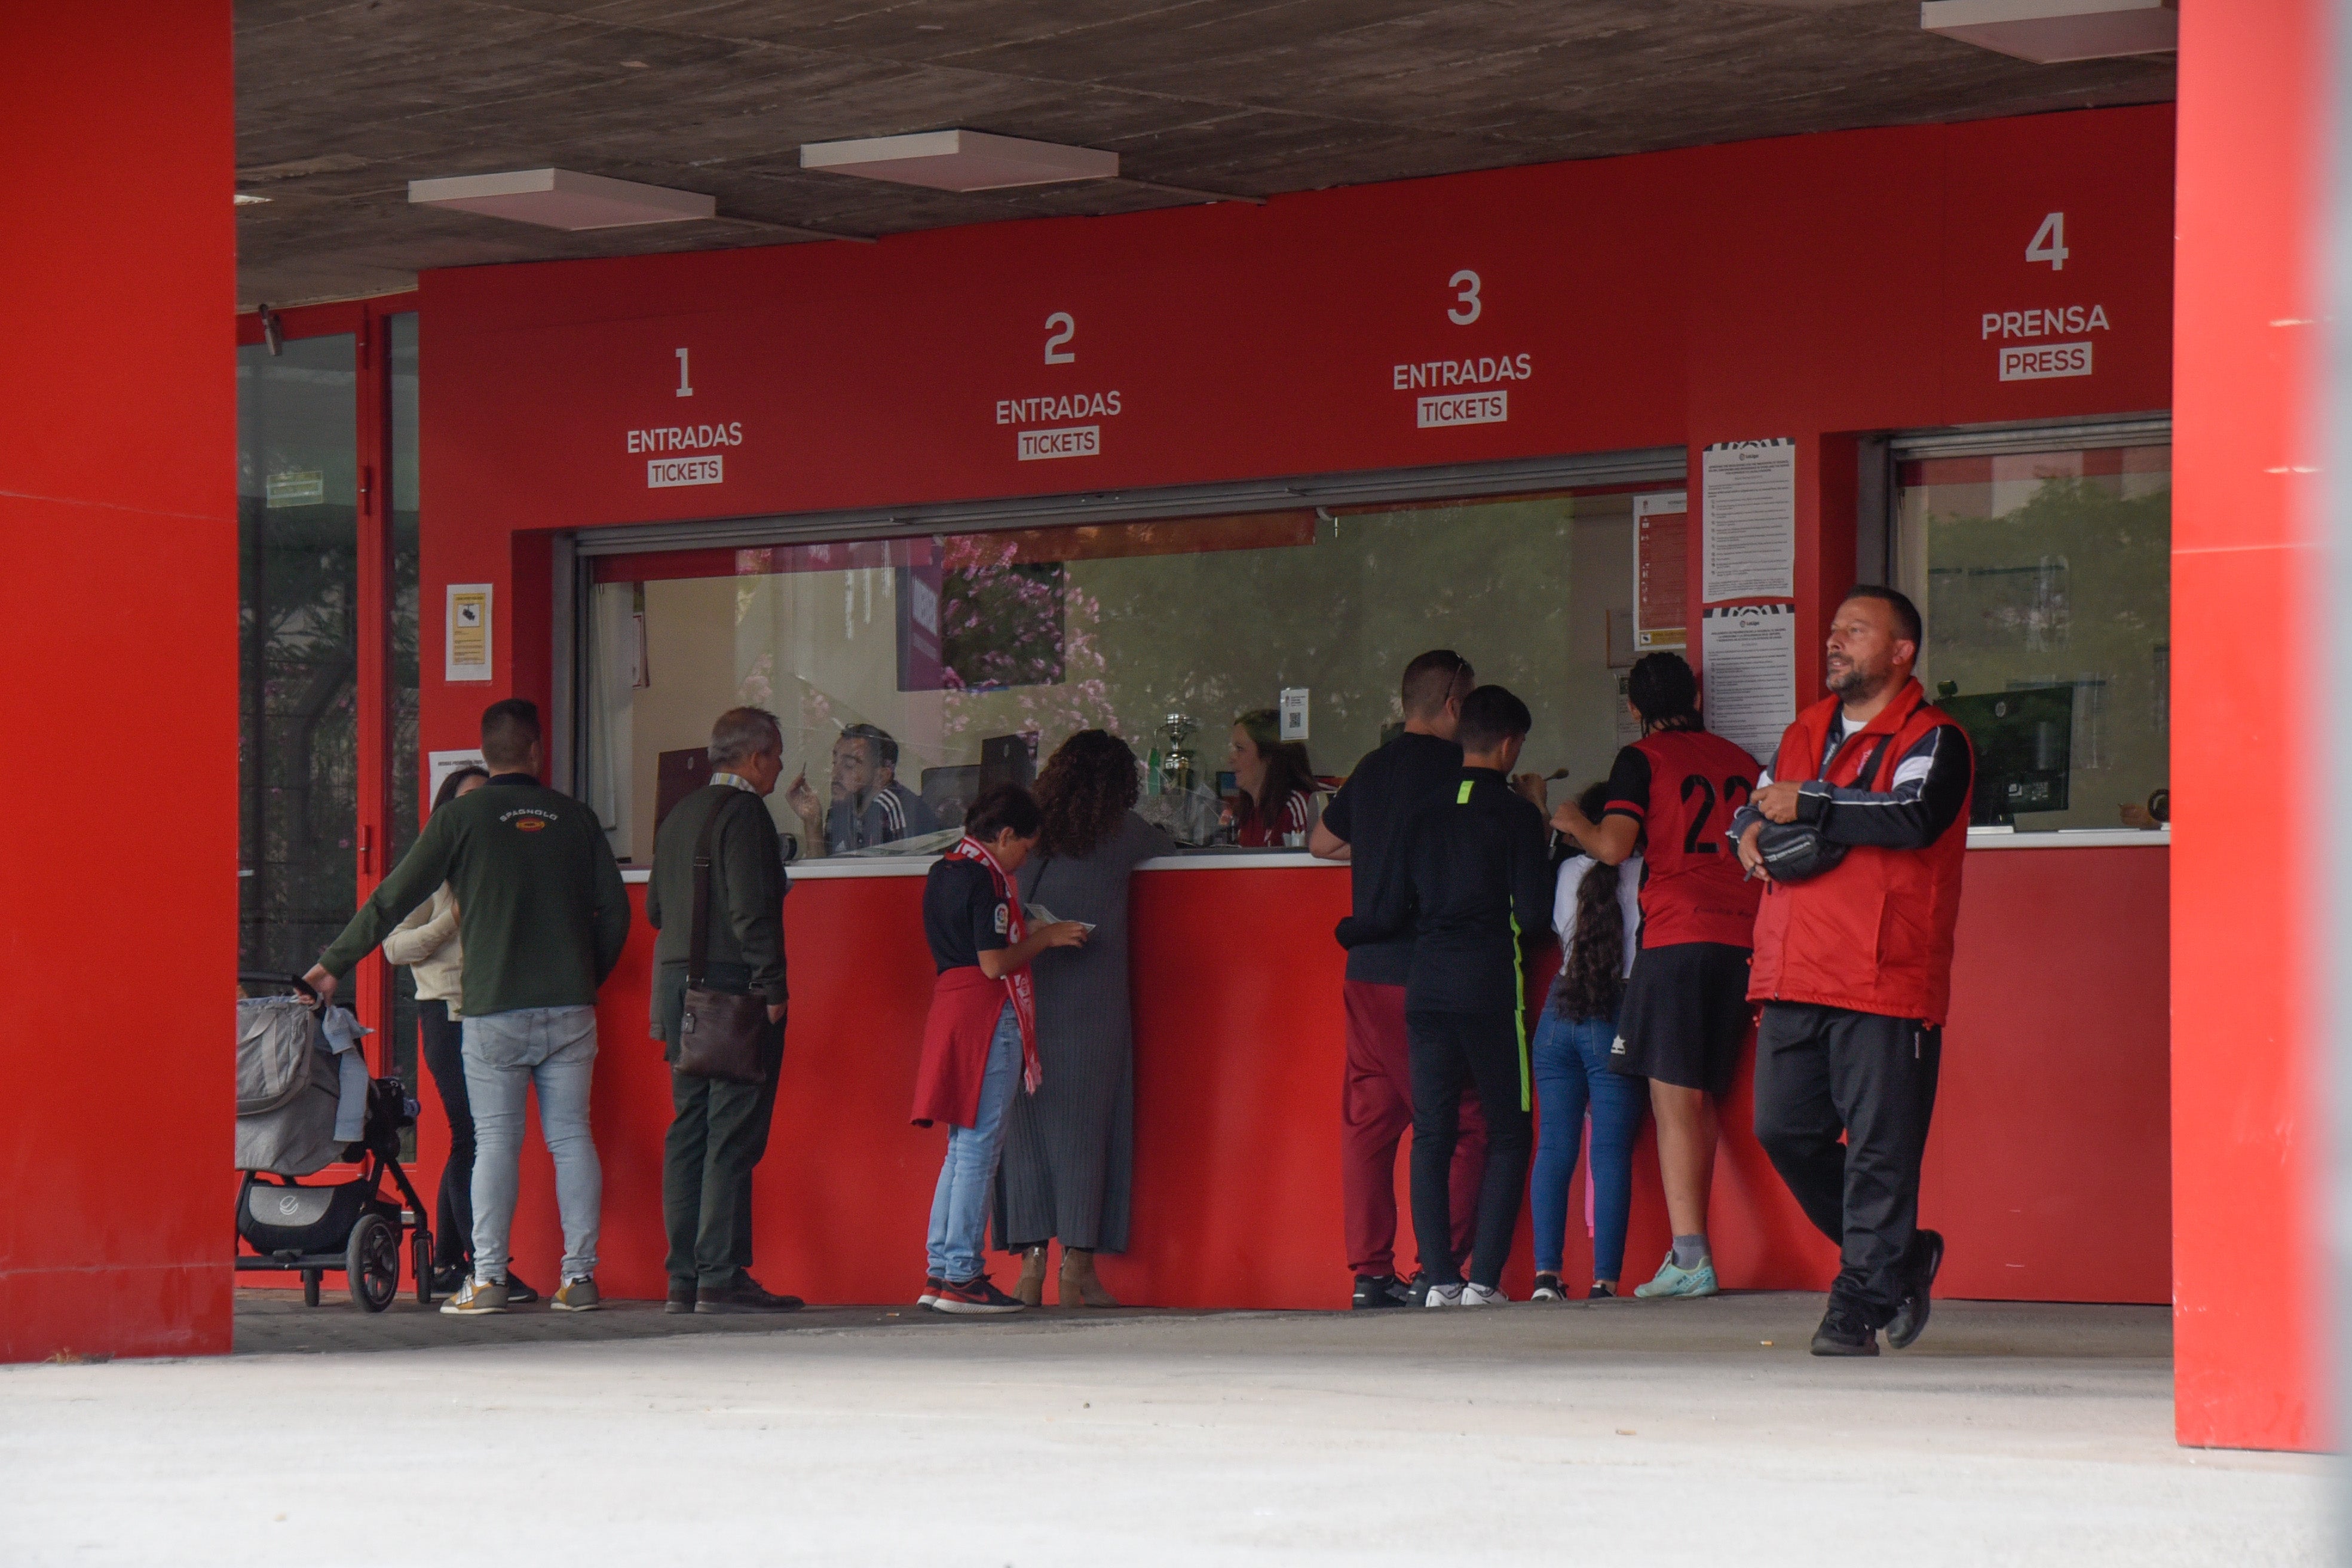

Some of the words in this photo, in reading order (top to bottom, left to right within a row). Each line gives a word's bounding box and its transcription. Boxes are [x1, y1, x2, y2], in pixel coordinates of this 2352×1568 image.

[2025, 212, 2069, 270] 4
[1447, 270, 1482, 325] 3
[1045, 312, 1075, 365] 2
[1982, 304, 2110, 339] PRENSA
[676, 348, 693, 397] 1
[1394, 354, 1532, 391] ENTRADAS
[2006, 345, 2085, 374] PRESS
[997, 391, 1122, 425] ENTRADAS
[1423, 394, 1502, 422] TICKETS
[628, 422, 742, 453] ENTRADAS
[1023, 430, 1095, 456] TICKETS
[653, 461, 719, 482] TICKETS
[500, 808, 558, 822] SPAGNOLO
